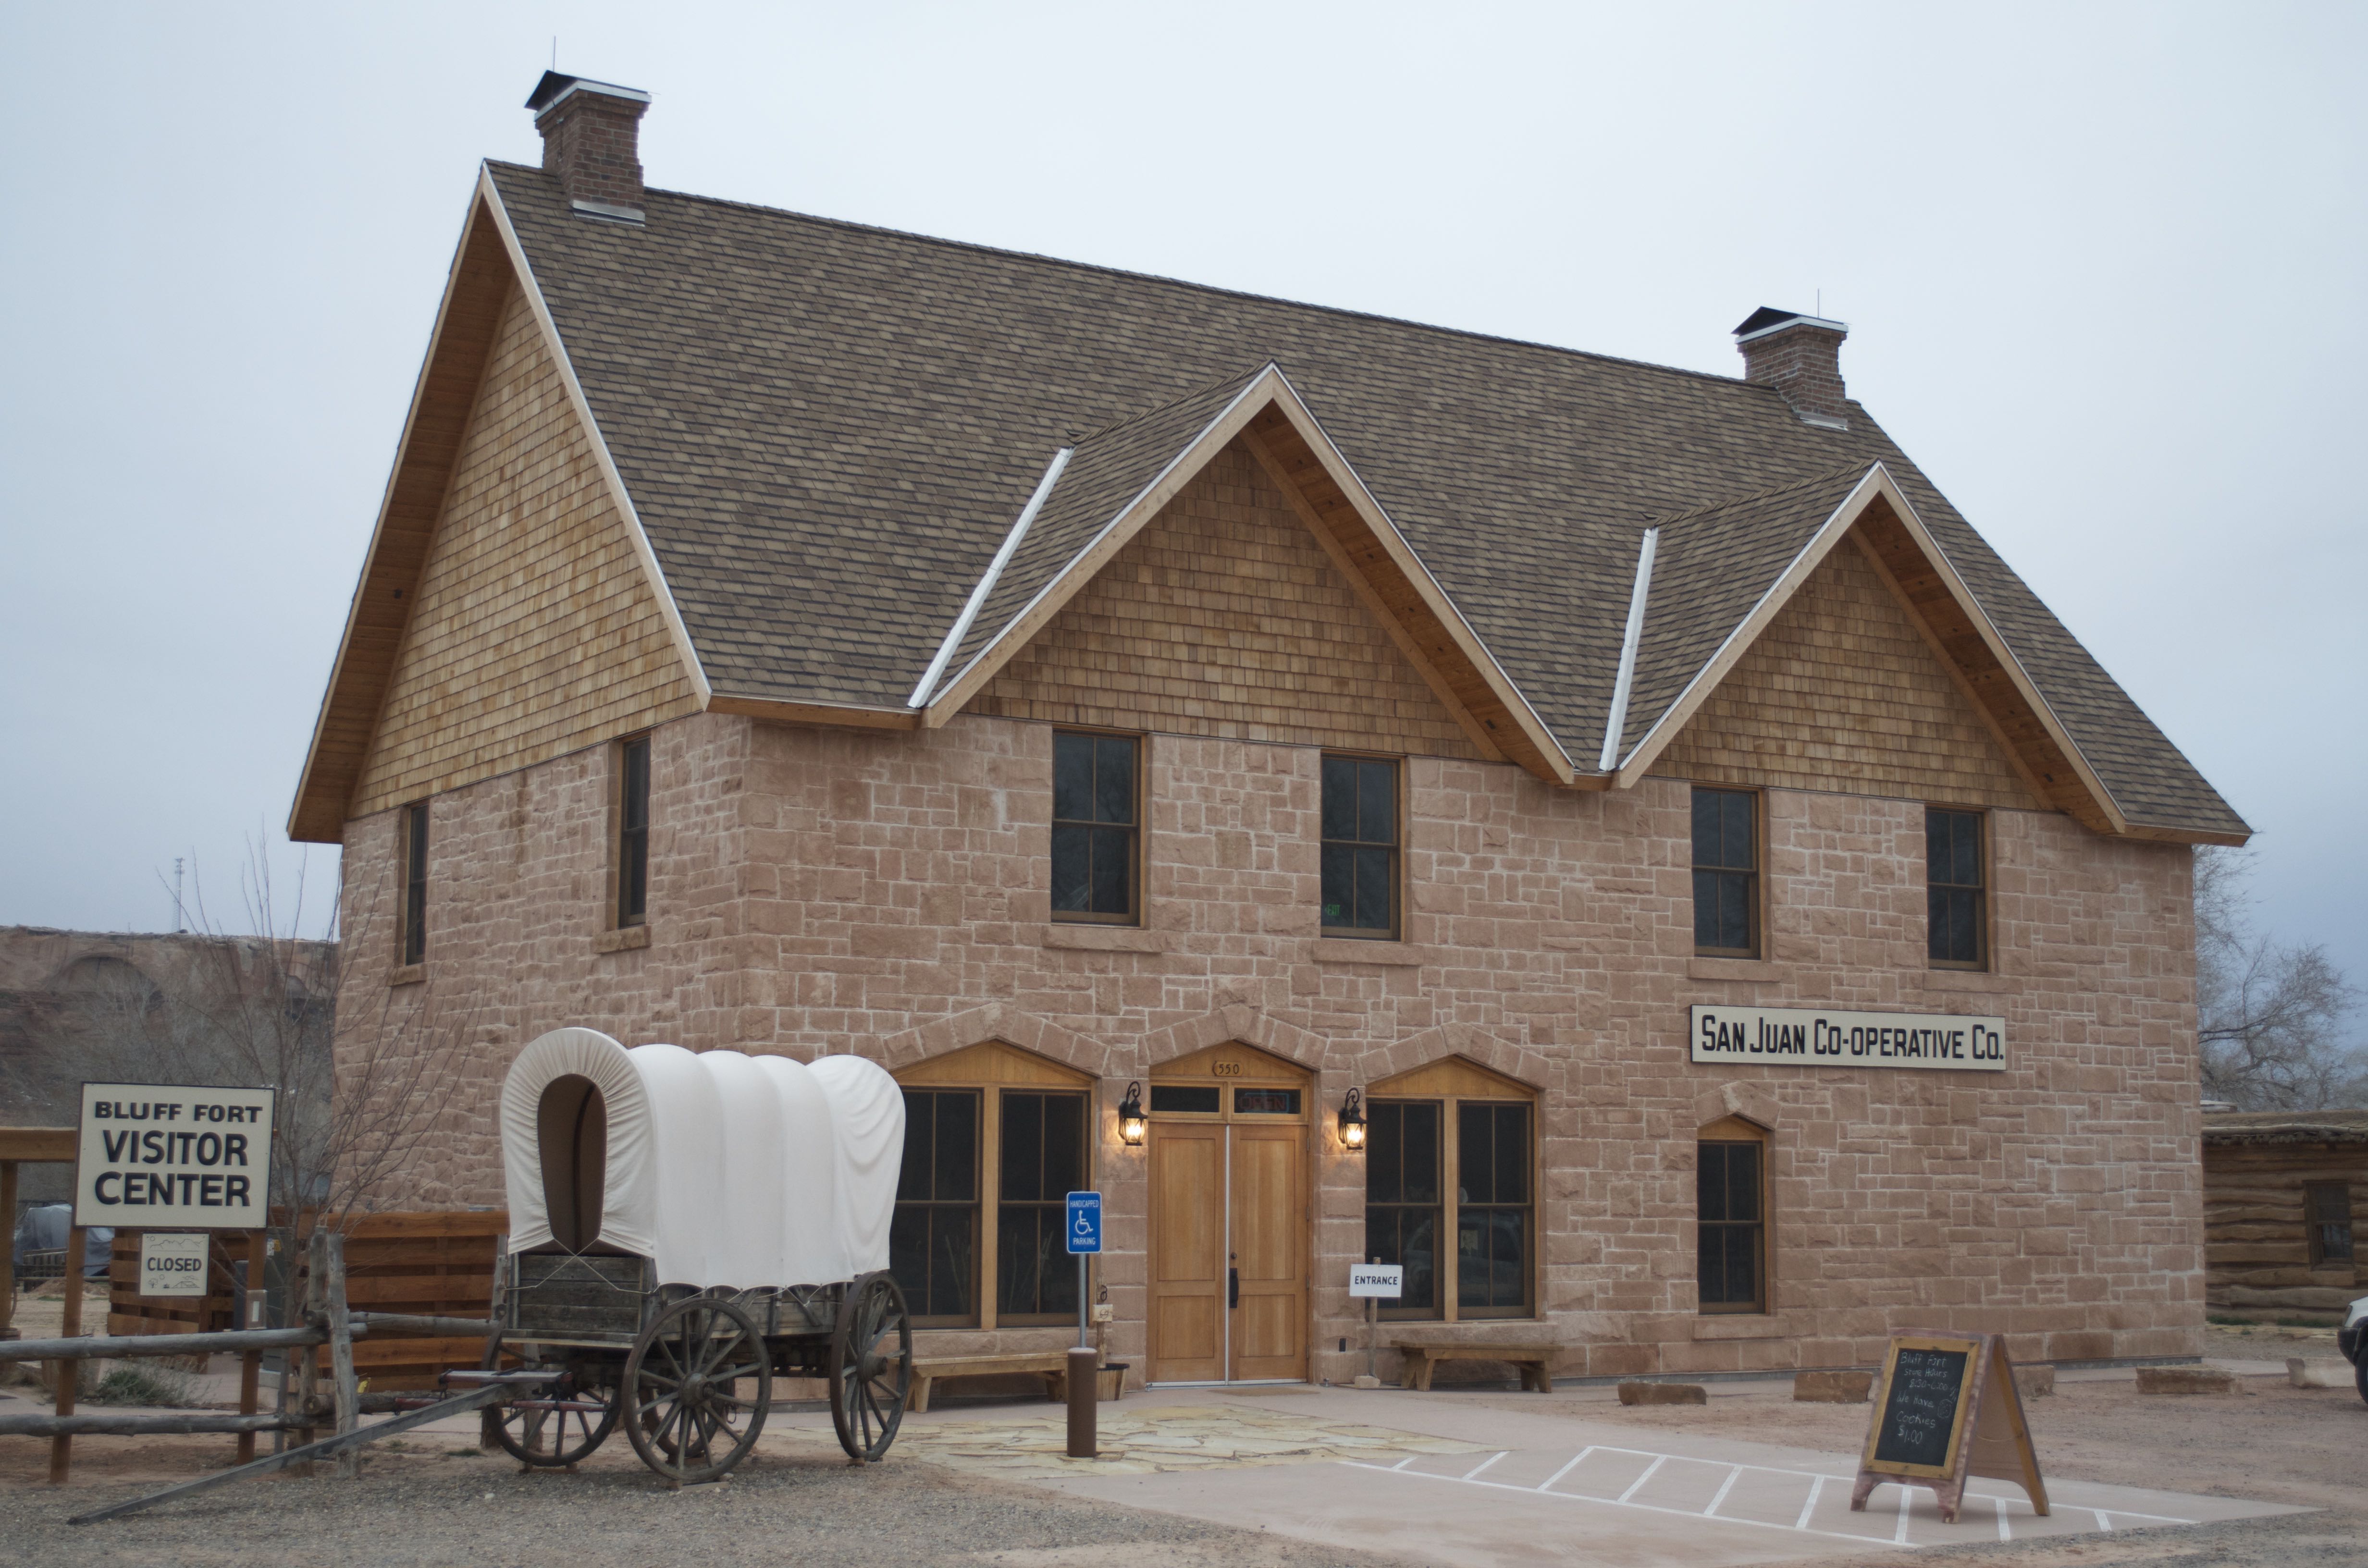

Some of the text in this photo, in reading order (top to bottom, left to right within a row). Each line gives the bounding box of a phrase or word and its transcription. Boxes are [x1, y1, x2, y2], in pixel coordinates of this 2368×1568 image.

[1327, 904, 1340, 915] EXIT
[1702, 1014, 2004, 1060] SAN JUAN CO-OPERATIVE CO.
[1219, 1064, 1239, 1075] 550
[1240, 1096, 1285, 1110] OPEN
[95, 1101, 263, 1123] BLUFF FORT
[103, 1129, 248, 1166] VISITOR
[95, 1171, 251, 1207] CENTER
[147, 1256, 202, 1272] CLOSED
[1355, 1275, 1398, 1285] ENTRANCE
[1900, 1352, 1923, 1364] Bluff
[1925, 1368, 1948, 1378] Hours
[1897, 1391, 1934, 1408] We Have
[1896, 1410, 1936, 1429] Cookies
[1898, 1425, 1923, 1445] $1.00
